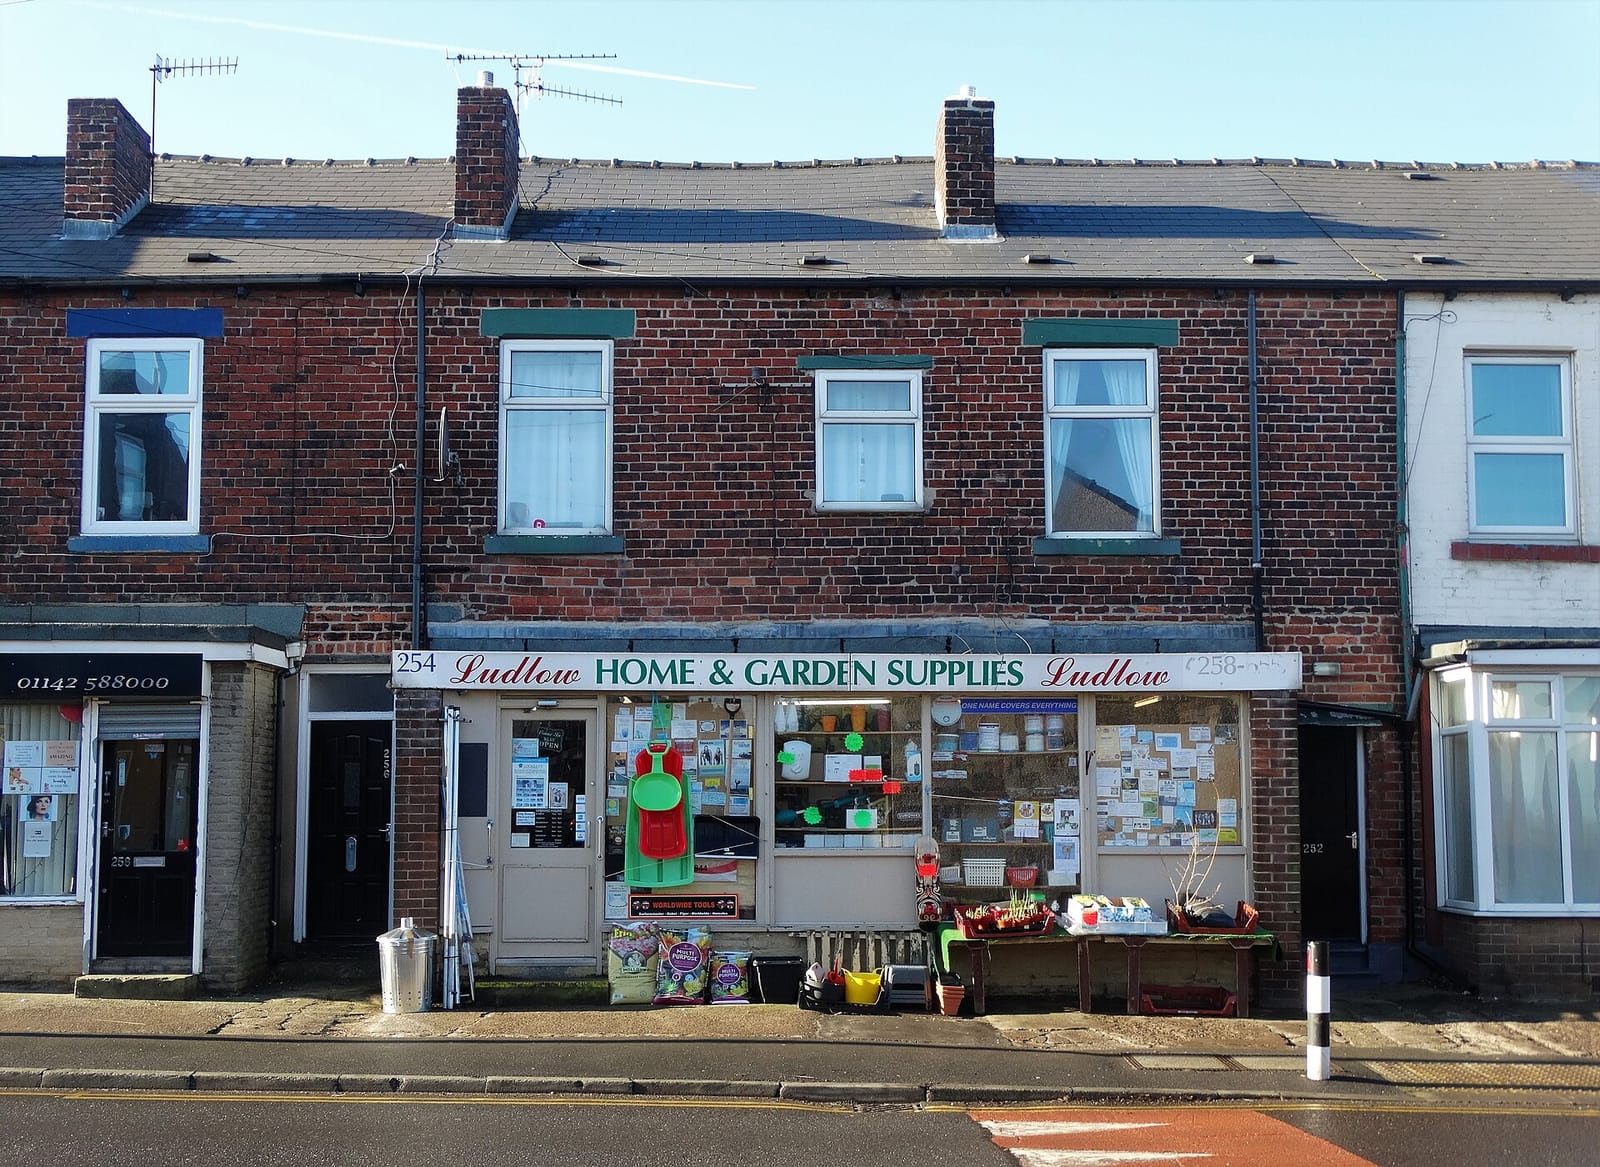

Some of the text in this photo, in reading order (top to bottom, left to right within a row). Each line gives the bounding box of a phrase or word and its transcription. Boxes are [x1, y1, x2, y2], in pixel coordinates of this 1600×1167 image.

[397, 652, 436, 673] 254
[450, 654, 581, 684] Ludlow
[596, 658, 694, 685] HOME
[709, 659, 733, 685] &
[744, 659, 876, 686] GARDEN
[887, 659, 1024, 687] SUPPLIES
[1041, 657, 1170, 687] Ludlow
[17, 675, 169, 691] 01142 588000
[540, 741, 559, 749] OPEN
[1303, 843, 1323, 854] 252
[112, 856, 130, 867] 258
[672, 953, 697, 961] PURPOSE
[676, 949, 694, 957] MULTI
